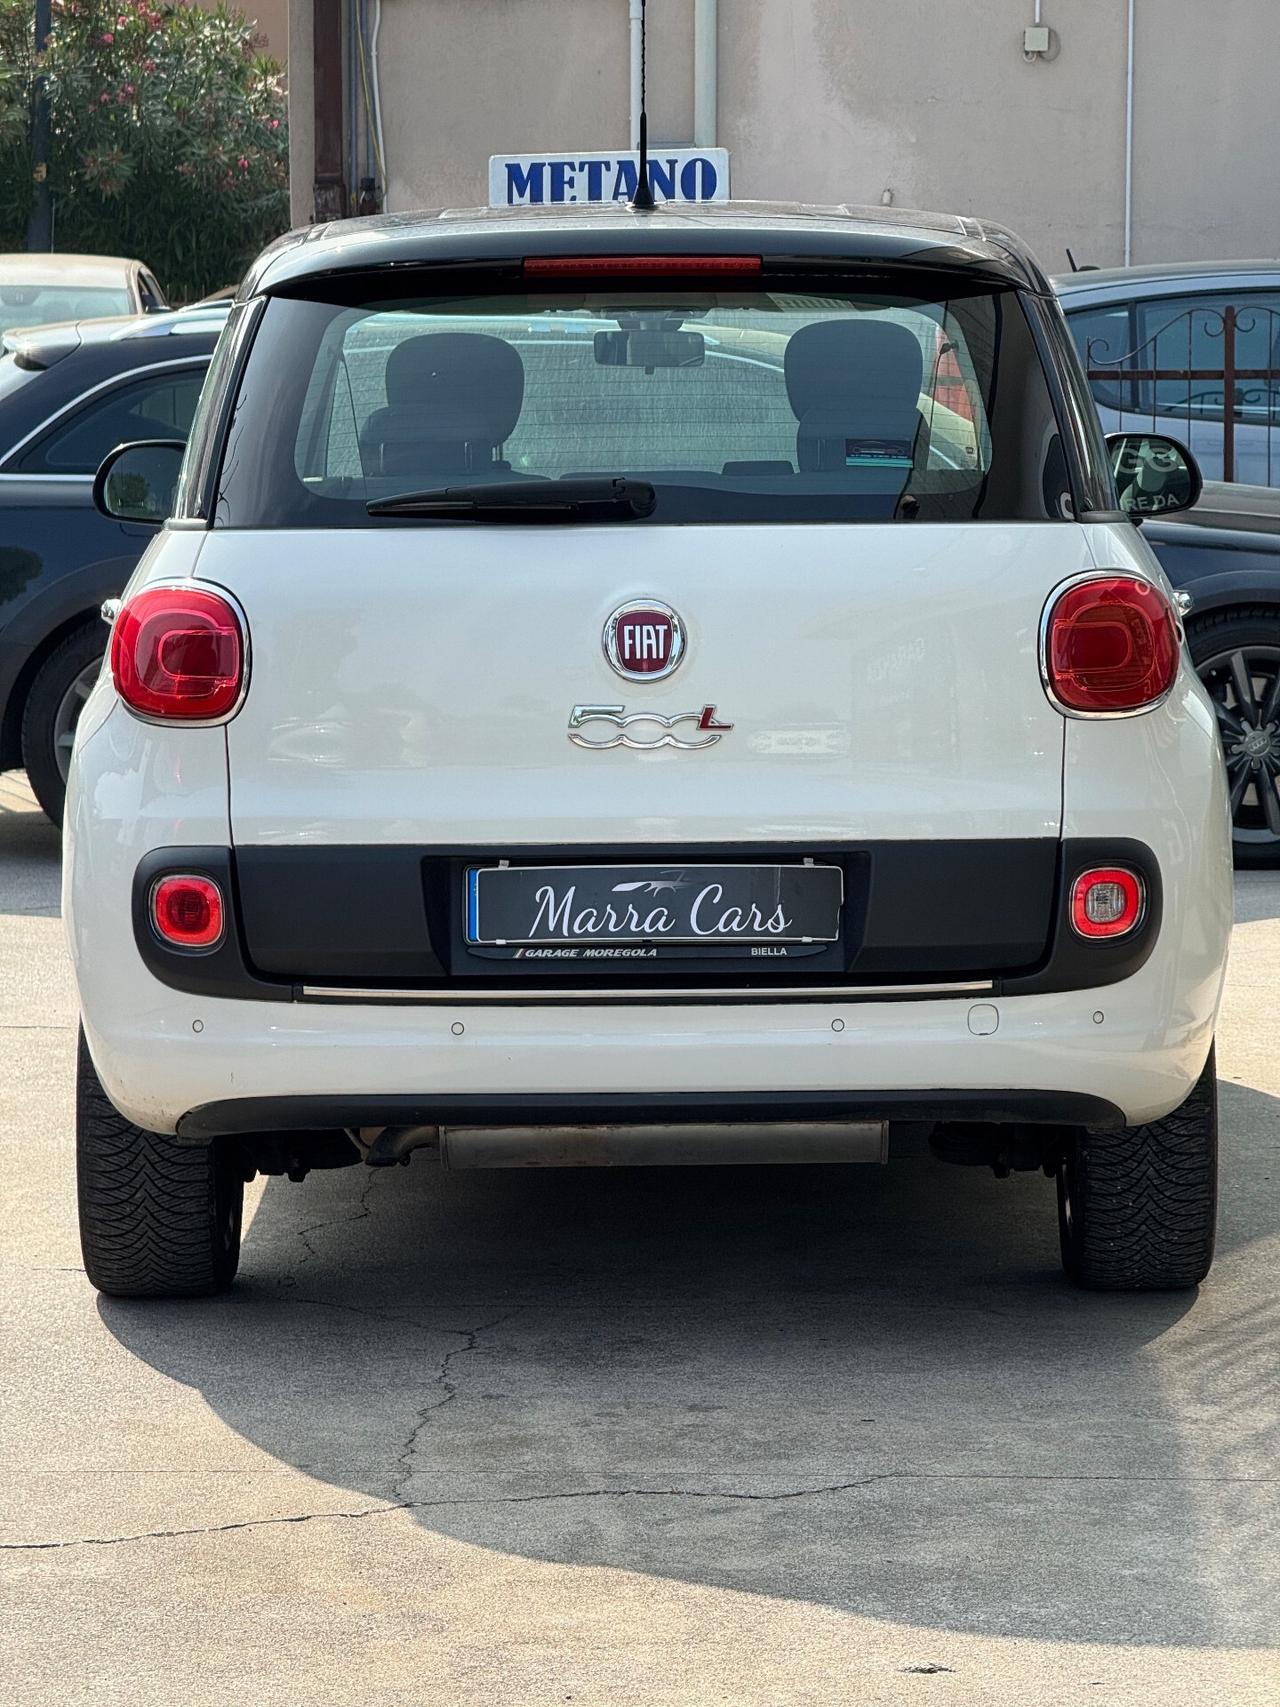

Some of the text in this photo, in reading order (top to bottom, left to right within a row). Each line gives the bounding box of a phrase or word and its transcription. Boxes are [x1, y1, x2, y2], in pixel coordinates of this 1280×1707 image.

[505, 157, 717, 206] METANO
[623, 625, 668, 659] FIAT
[568, 704, 734, 750] 500L
[528, 883, 793, 938] Marra Cars
[525, 947, 788, 958] GARAGE MOREGOLA BIELLA
